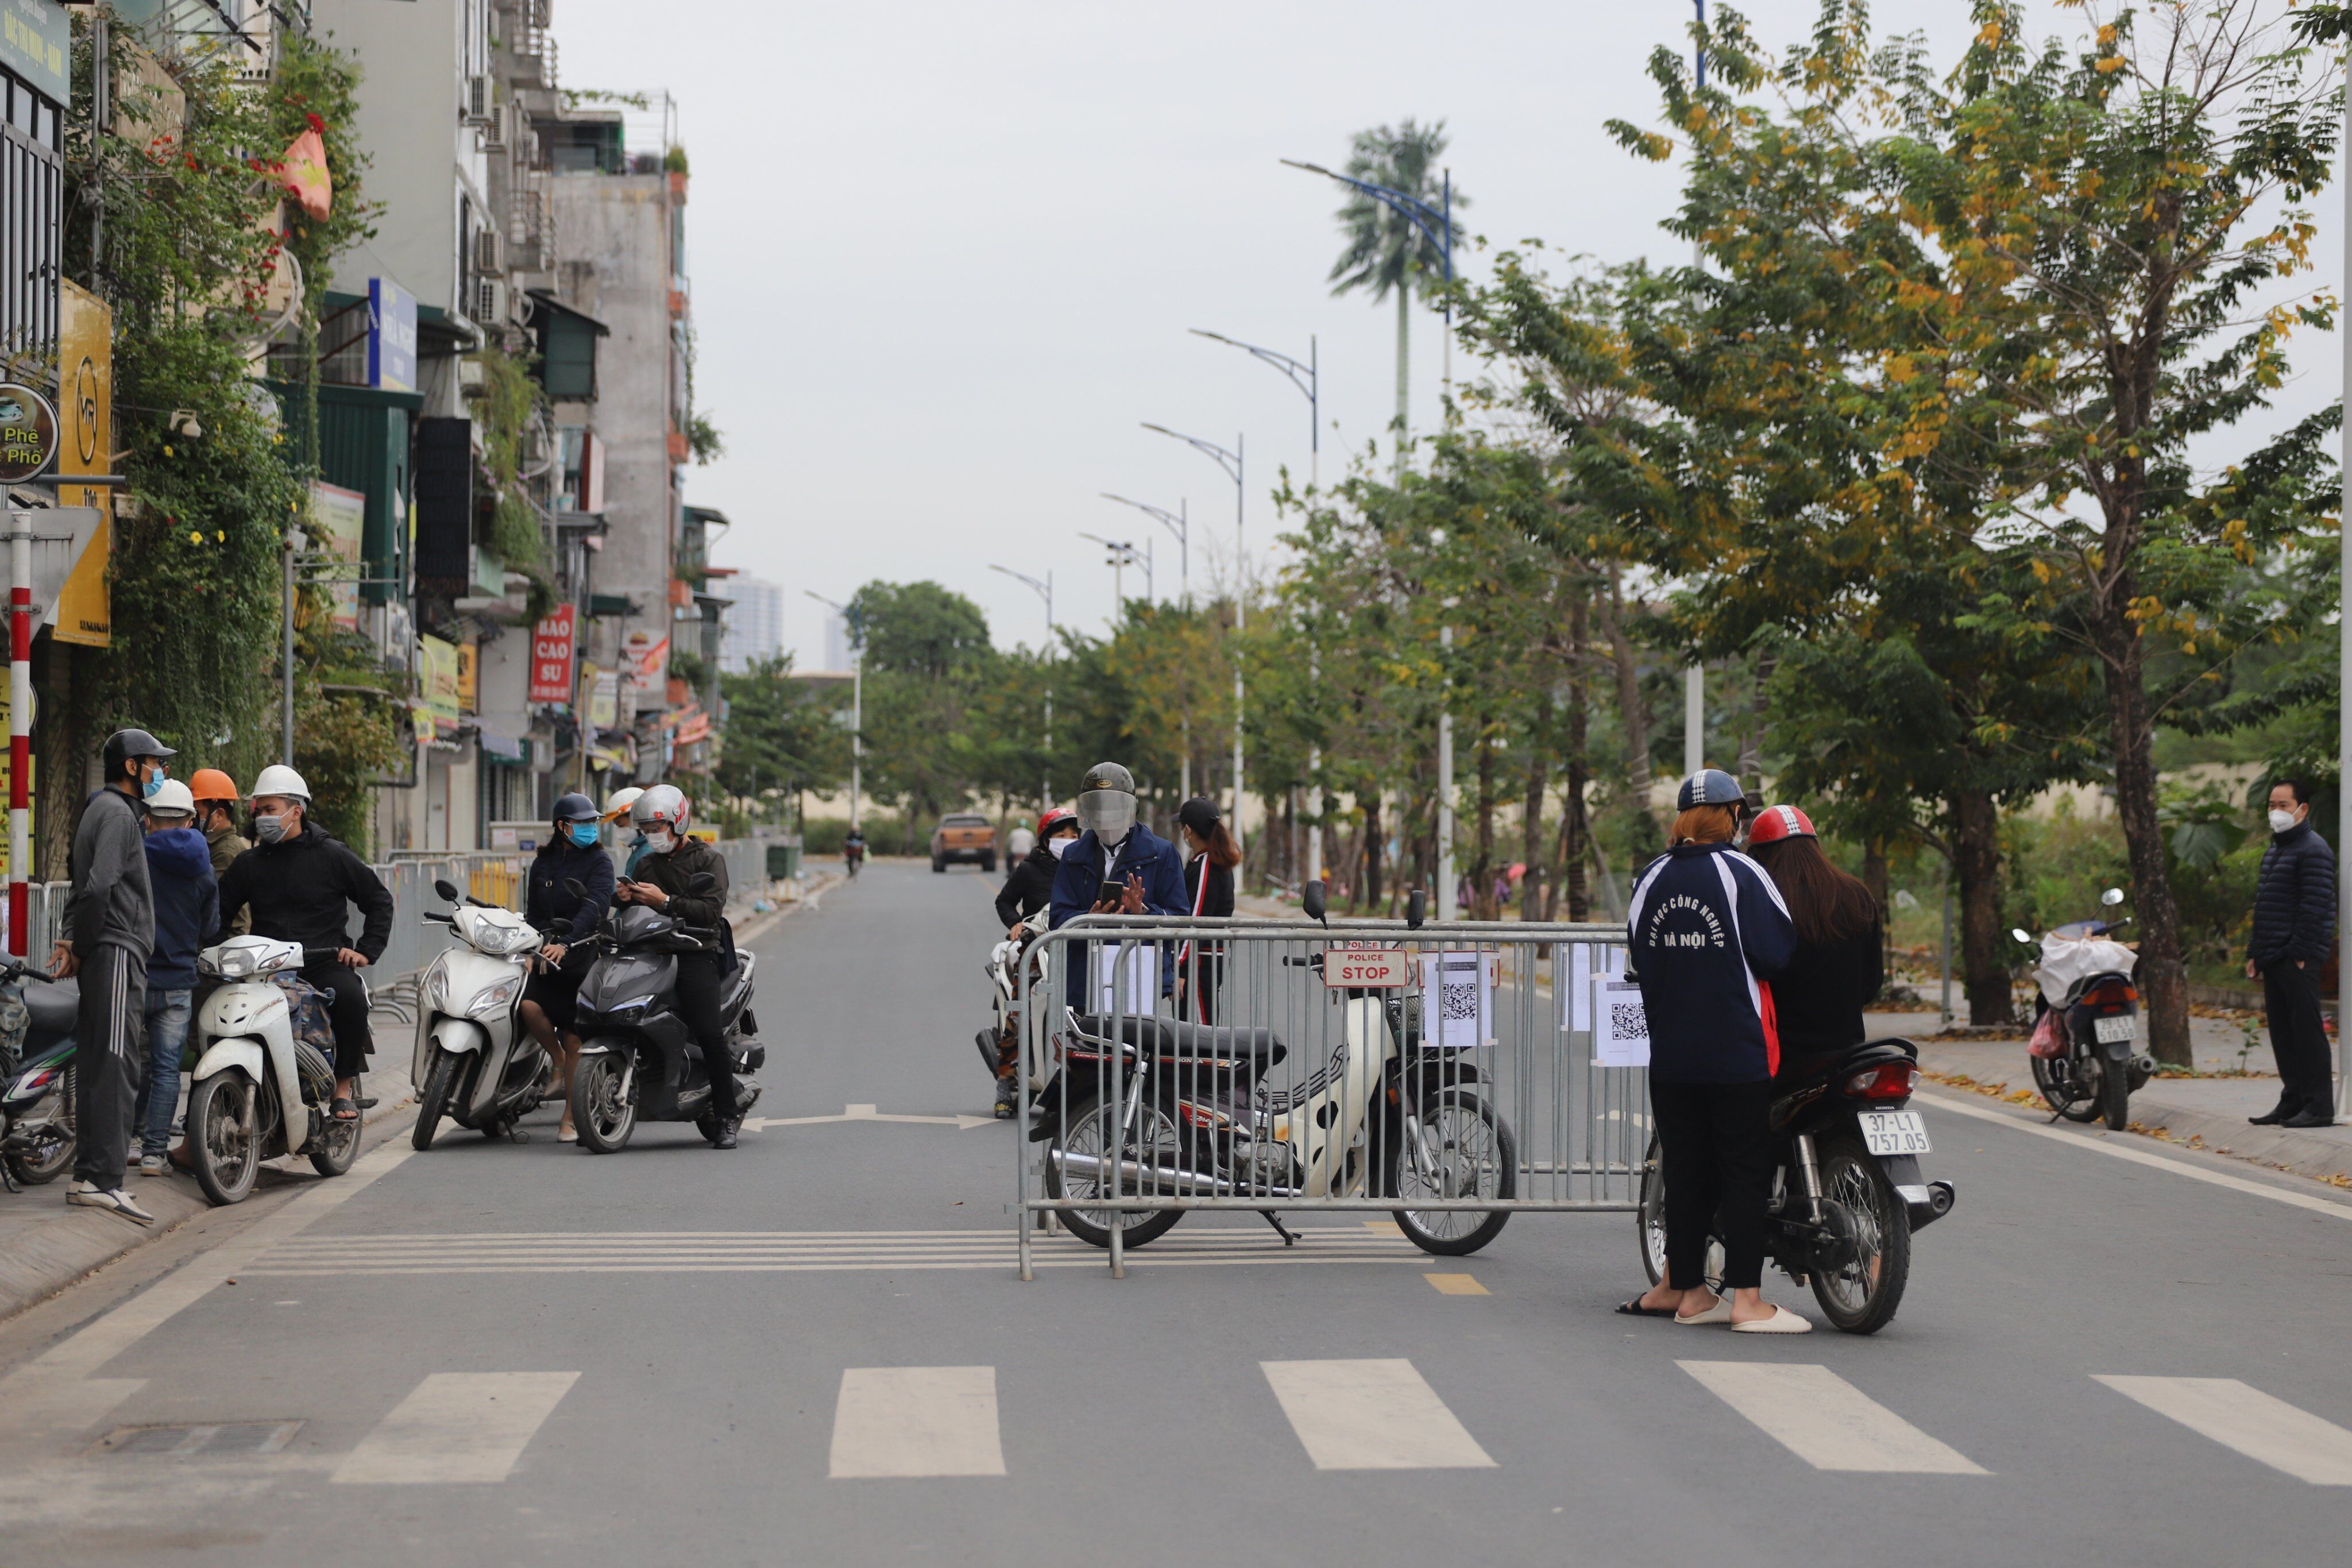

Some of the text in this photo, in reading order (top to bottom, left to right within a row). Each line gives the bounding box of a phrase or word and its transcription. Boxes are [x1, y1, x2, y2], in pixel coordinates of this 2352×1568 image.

[5, 427, 38, 443] Phê
[7, 449, 44, 465] Phố
[538, 619, 570, 637] BAO
[537, 642, 569, 659] CAO
[541, 664, 562, 682] SU
[1652, 903, 1668, 925] HỌC
[1670, 894, 1699, 910] CÔNG
[1699, 905, 1725, 947] NGHIỆP
[1680, 931, 1705, 949] NỘI
[1342, 967, 1389, 979] STOP
[1868, 1114, 1914, 1131] 37-L1
[1869, 1133, 1927, 1152] 757.05
